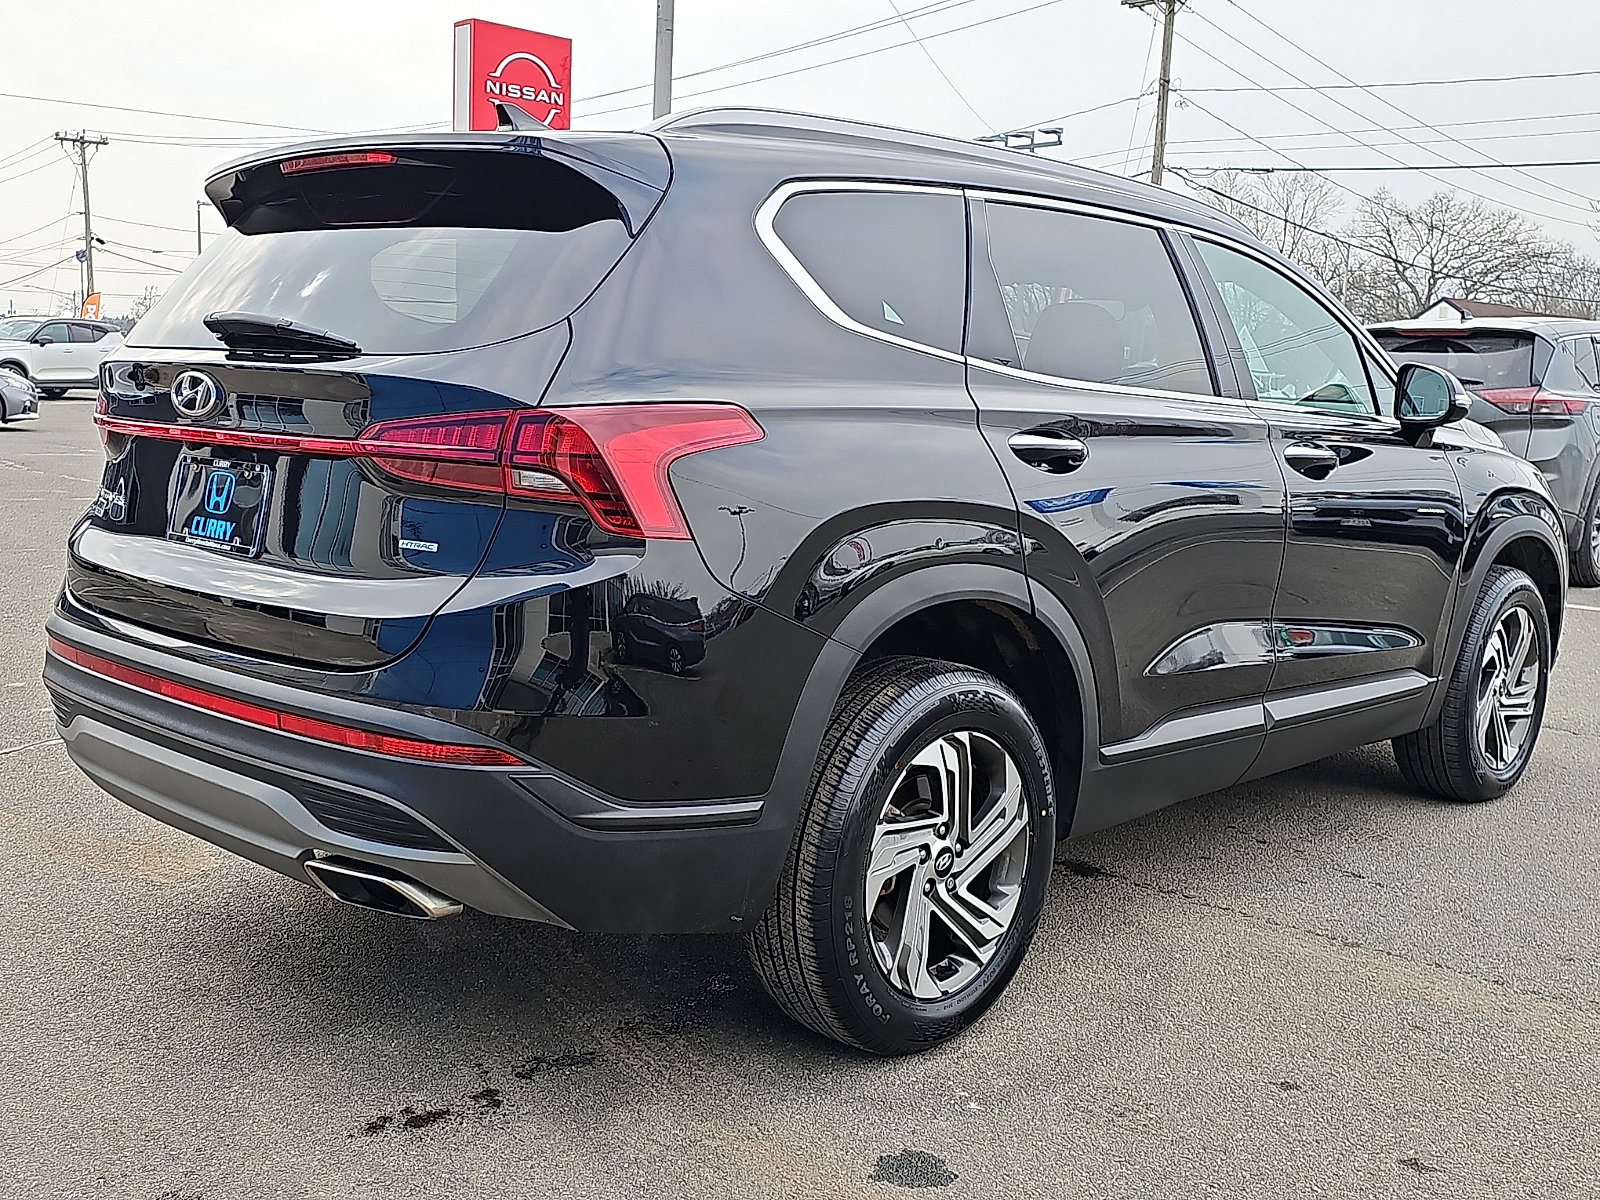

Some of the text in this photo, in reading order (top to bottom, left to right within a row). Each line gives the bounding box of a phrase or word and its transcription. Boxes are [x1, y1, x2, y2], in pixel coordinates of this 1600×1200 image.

[485, 79, 564, 106] NISSAN
[212, 460, 232, 468] CURRY
[190, 515, 236, 541] CURRY
[400, 541, 435, 550] HTRAC
[853, 973, 891, 1025] FORAY
